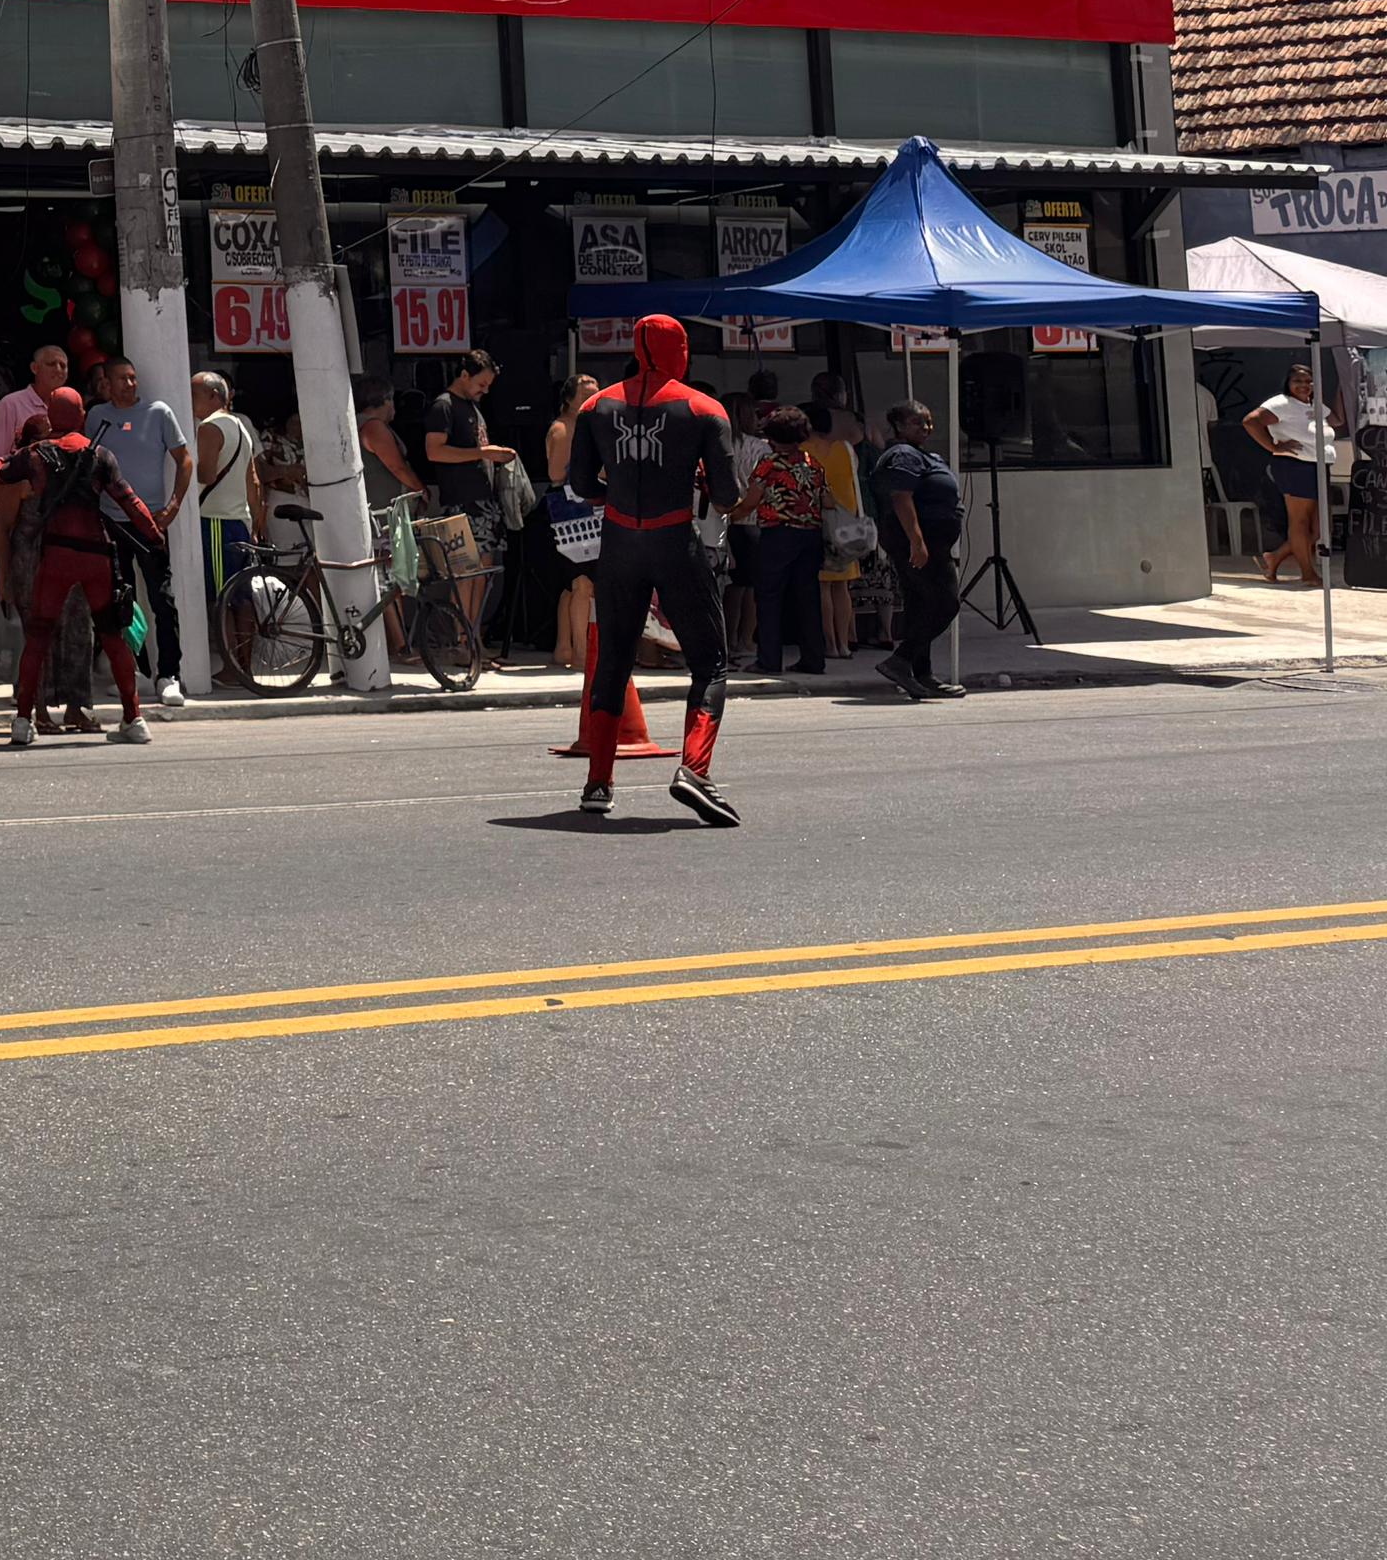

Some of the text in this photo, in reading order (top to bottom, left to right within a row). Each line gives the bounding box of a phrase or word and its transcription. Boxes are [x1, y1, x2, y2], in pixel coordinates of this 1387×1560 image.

[234, 185, 275, 202] OFERT
[412, 188, 457, 207] OFERTA
[1269, 176, 1379, 229] TROCA
[1044, 201, 1082, 217] OFERTA
[579, 224, 643, 253] ASA
[721, 226, 784, 257] ARROZ
[1044, 242, 1067, 253] SKOL
[579, 254, 593, 266] DE
[214, 285, 291, 346] 6,49
[393, 288, 467, 346] 15,97
